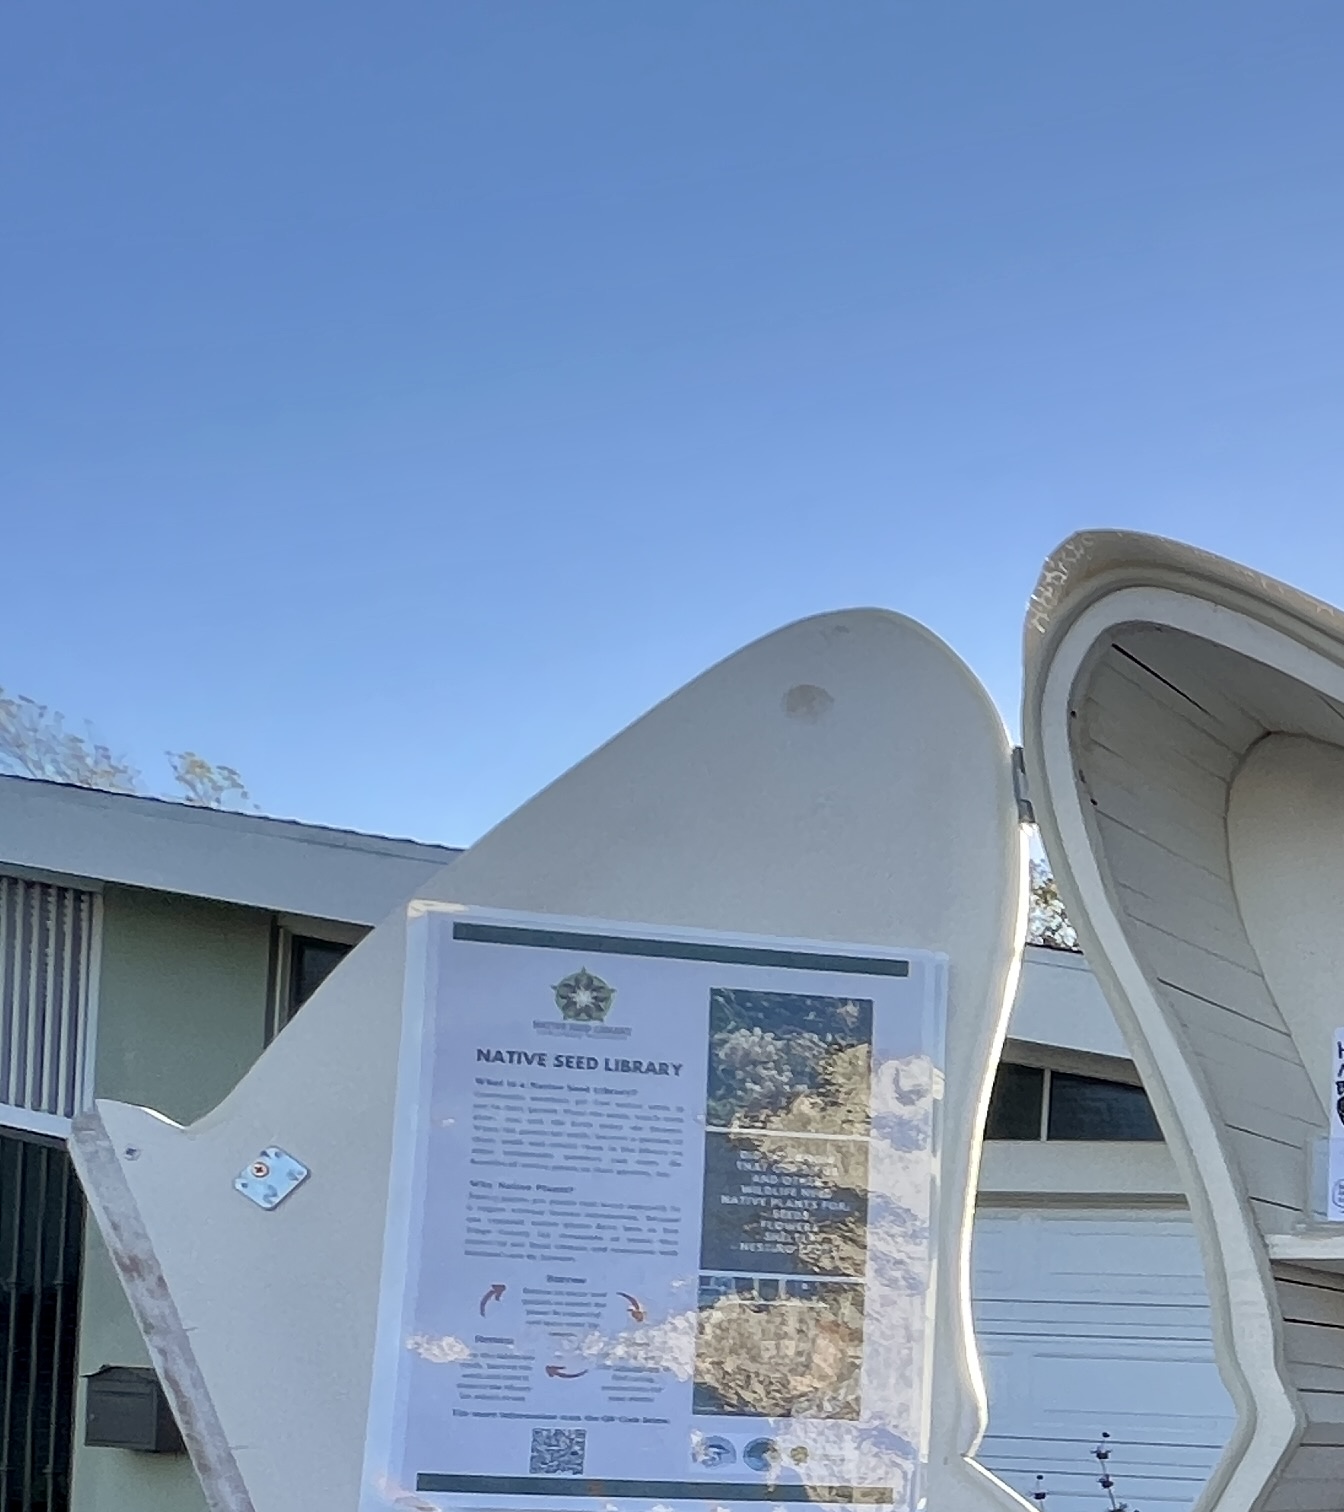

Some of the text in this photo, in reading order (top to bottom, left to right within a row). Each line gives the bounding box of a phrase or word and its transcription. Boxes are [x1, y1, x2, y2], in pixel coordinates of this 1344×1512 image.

[476, 1049, 683, 1076] NATIVE SEED LIBRARY
